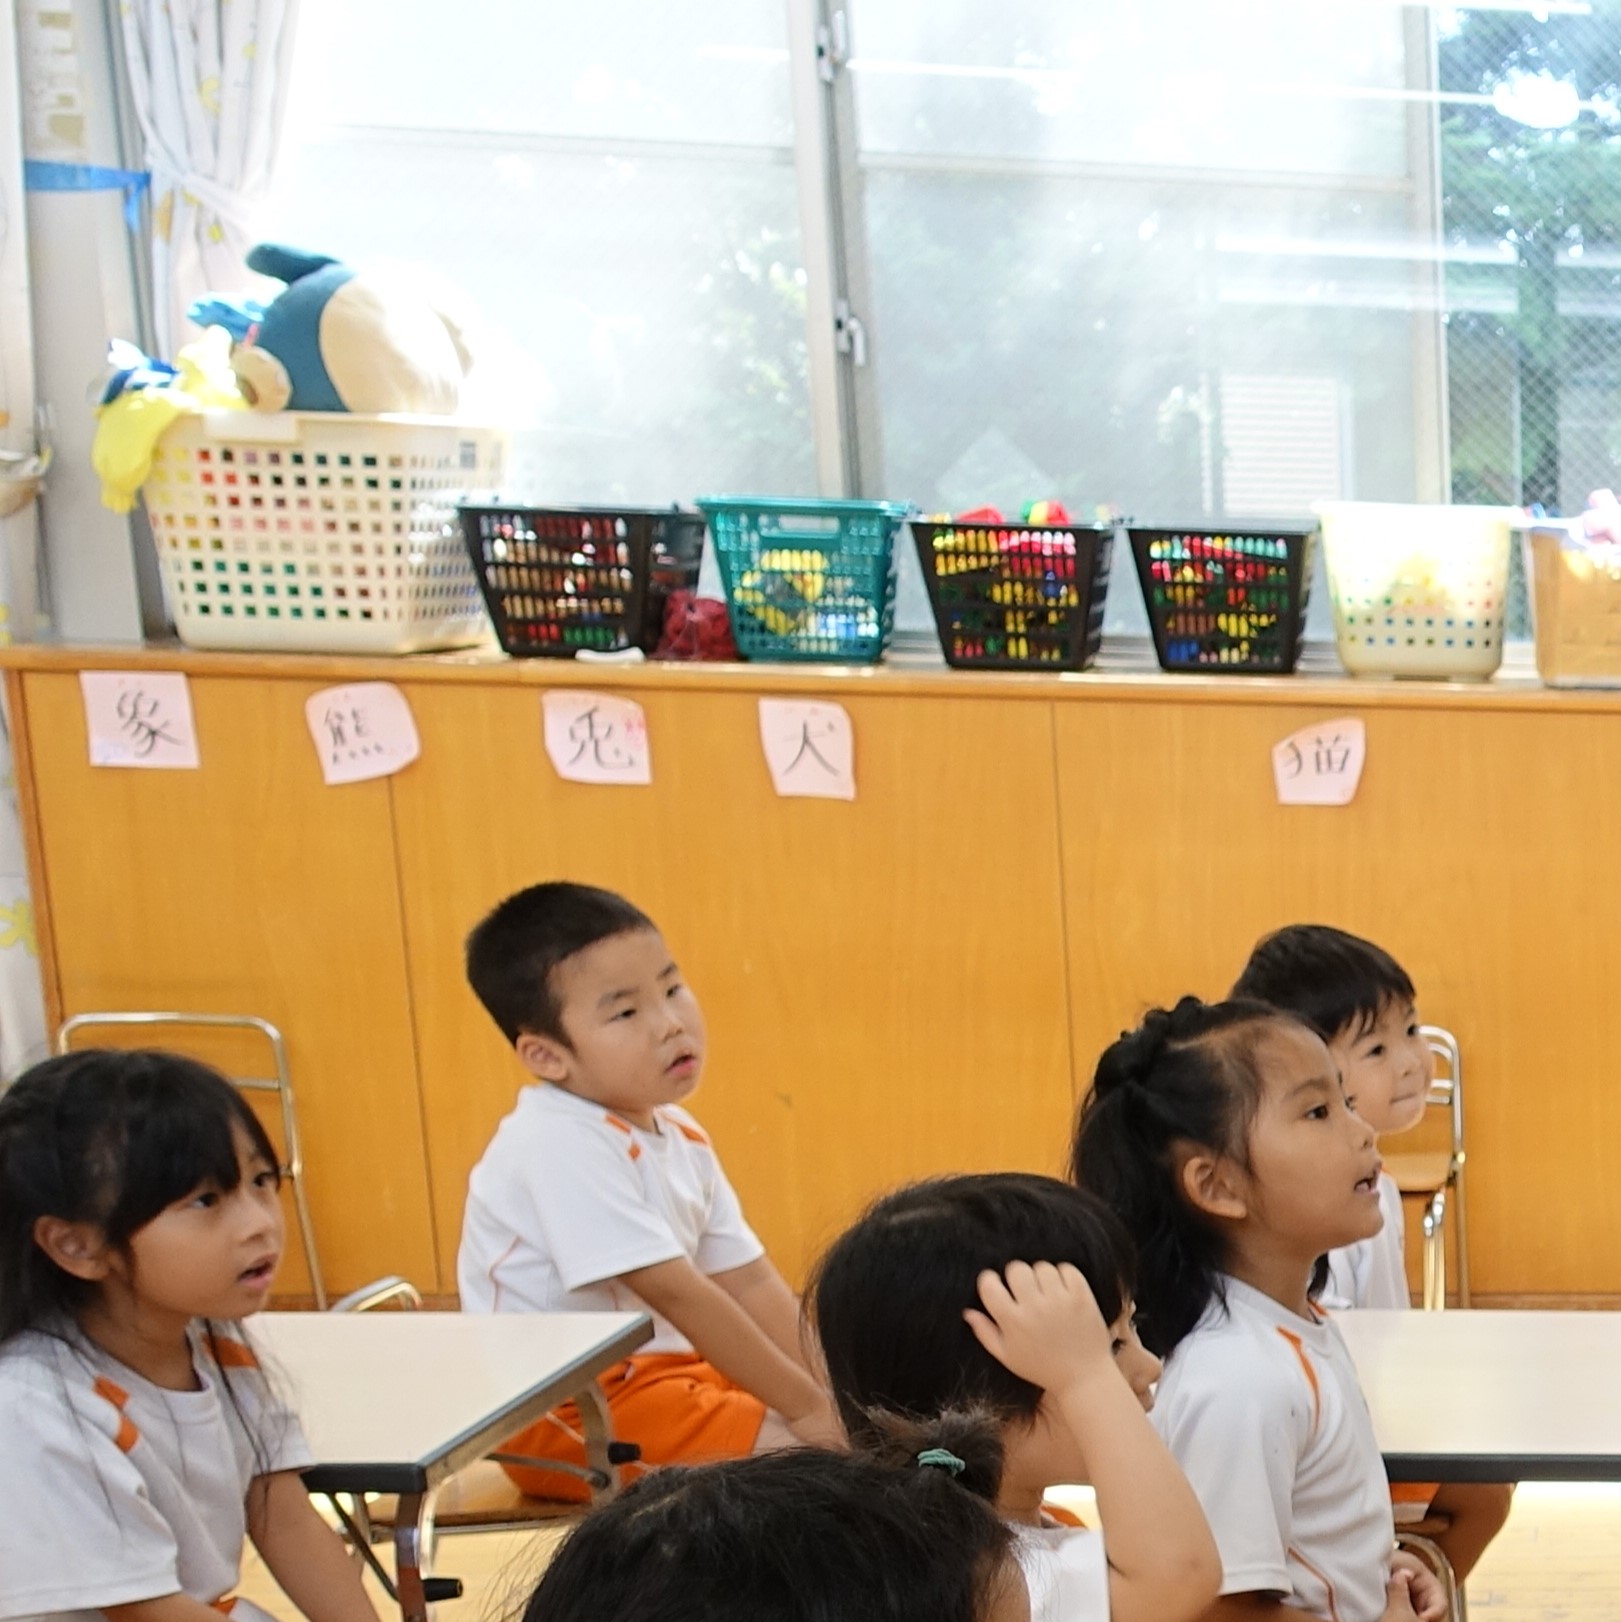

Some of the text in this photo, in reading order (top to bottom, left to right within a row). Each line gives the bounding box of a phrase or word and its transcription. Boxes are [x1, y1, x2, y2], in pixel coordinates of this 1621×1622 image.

[116, 690, 184, 758] 象
[324, 705, 384, 766] 熊
[783, 718, 840, 777] 犬
